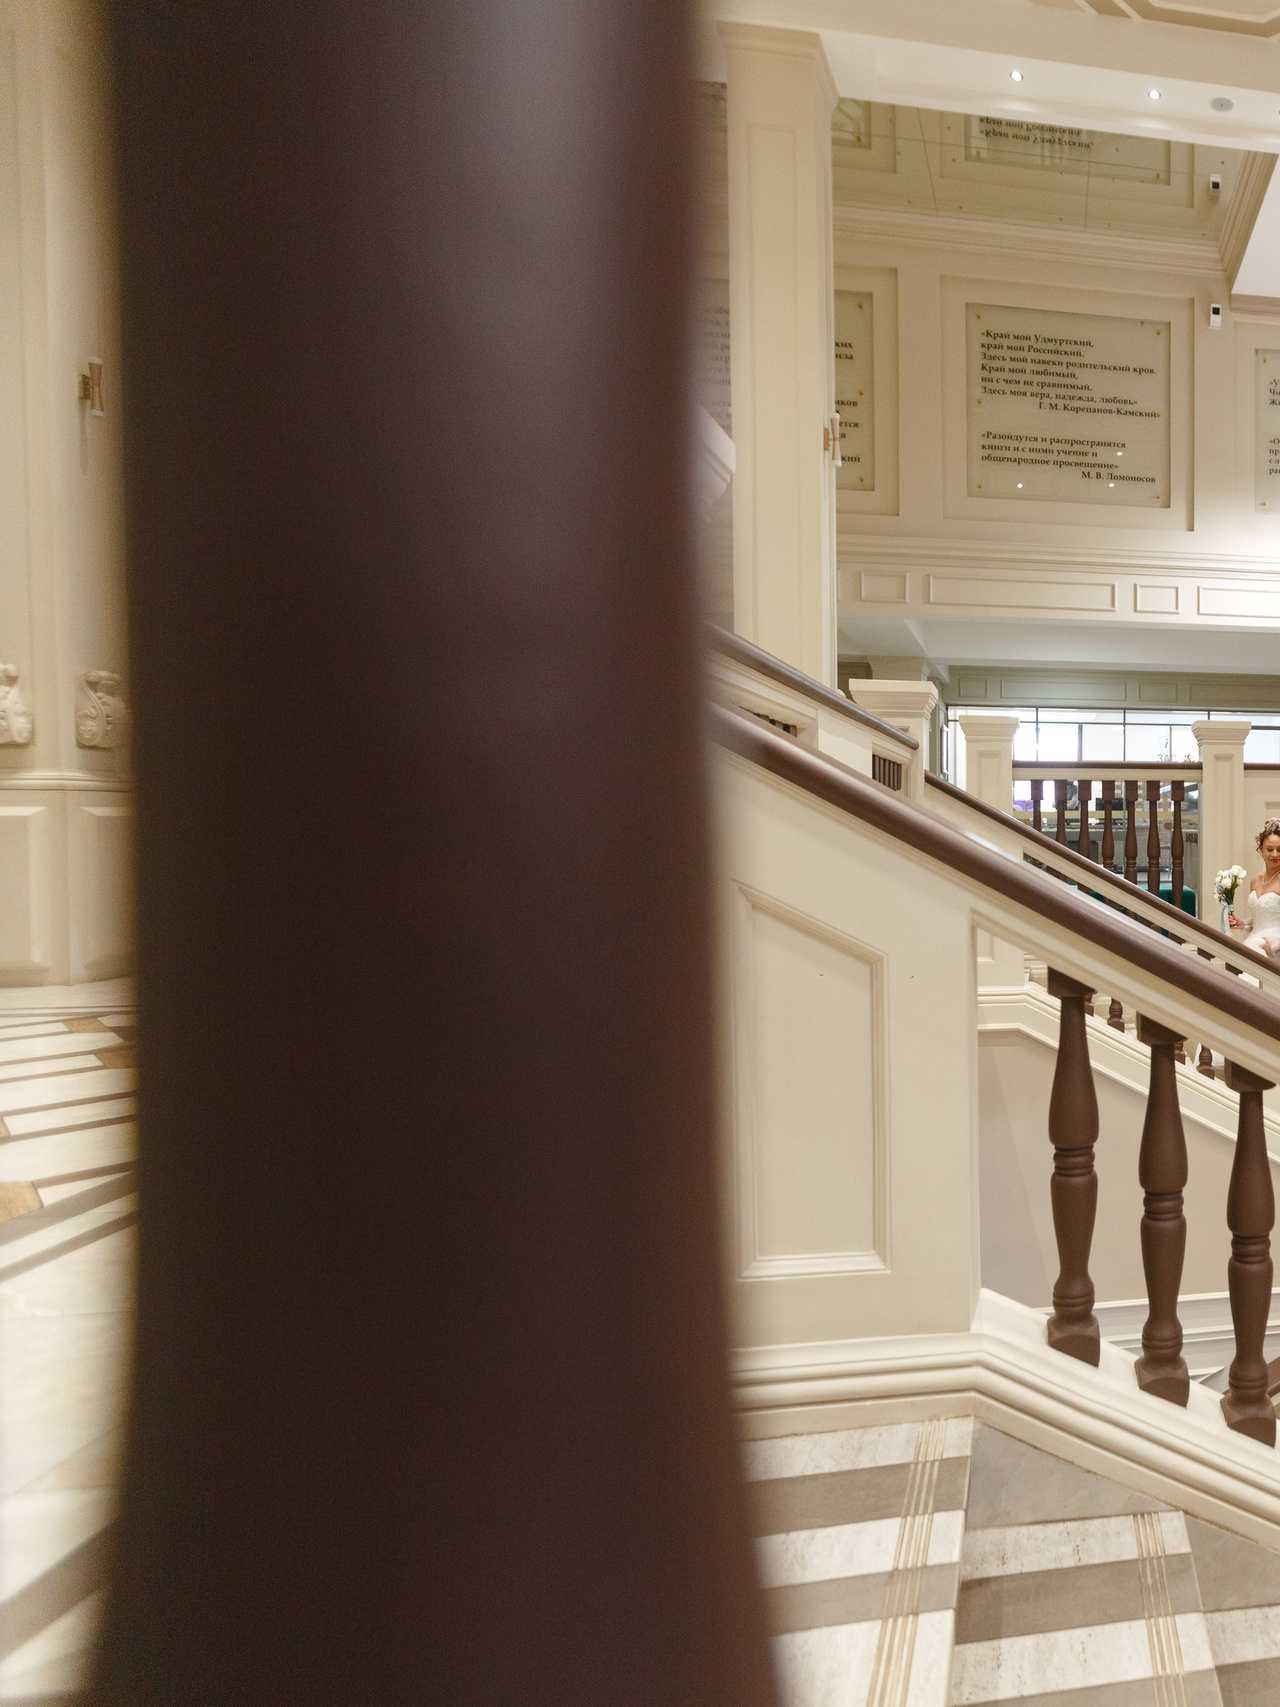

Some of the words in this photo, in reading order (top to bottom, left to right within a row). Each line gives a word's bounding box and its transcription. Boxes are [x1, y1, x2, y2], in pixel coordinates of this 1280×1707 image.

[981, 329, 1010, 341] «Край
[1012, 332, 1031, 342] мой
[1033, 333, 1094, 349] Удмуртский,
[981, 341, 1004, 351] край
[1006, 343, 1025, 352] мой
[1027, 344, 1085, 358] Российский.
[981, 352, 1007, 362] Здесь
[1009, 354, 1028, 364] мой
[1030, 357, 1064, 367] навеки
[1065, 360, 1131, 373] родительский
[1132, 365, 1157, 375] кров.
[981, 363, 1006, 374] Край
[1008, 365, 1027, 375] мой
[1028, 367, 1079, 380] любимый,
[981, 375, 995, 384] ни
[1002, 377, 1021, 386] чем
[1023, 379, 1035, 387] не
[1036, 381, 1093, 392] сравнимый.
[981, 385, 1007, 396] Здесь
[1009, 388, 1028, 397] моя
[1030, 390, 1053, 401] вера,
[1055, 392, 1098, 404] надежда,
[1099, 395, 1138, 406] любовь»
[1038, 401, 1047, 410] Г.
[1049, 402, 1061, 411] М.
[1062, 403, 1157, 418] Корепанов-Камский
[981, 430, 1039, 443] «Разойдутся
[1049, 437, 1126, 449] распространятся
[981, 443, 1011, 452] книги
[1028, 446, 1055, 455] ними
[1056, 449, 1090, 458] учение
[1092, 450, 1098, 458] и
[981, 453, 1051, 466] общенародное
[1052, 459, 1119, 470] просвещение»
[1081, 471, 1094, 480] М.
[1096, 472, 1104, 480] В.
[1106, 472, 1156, 483] Ломоносов
